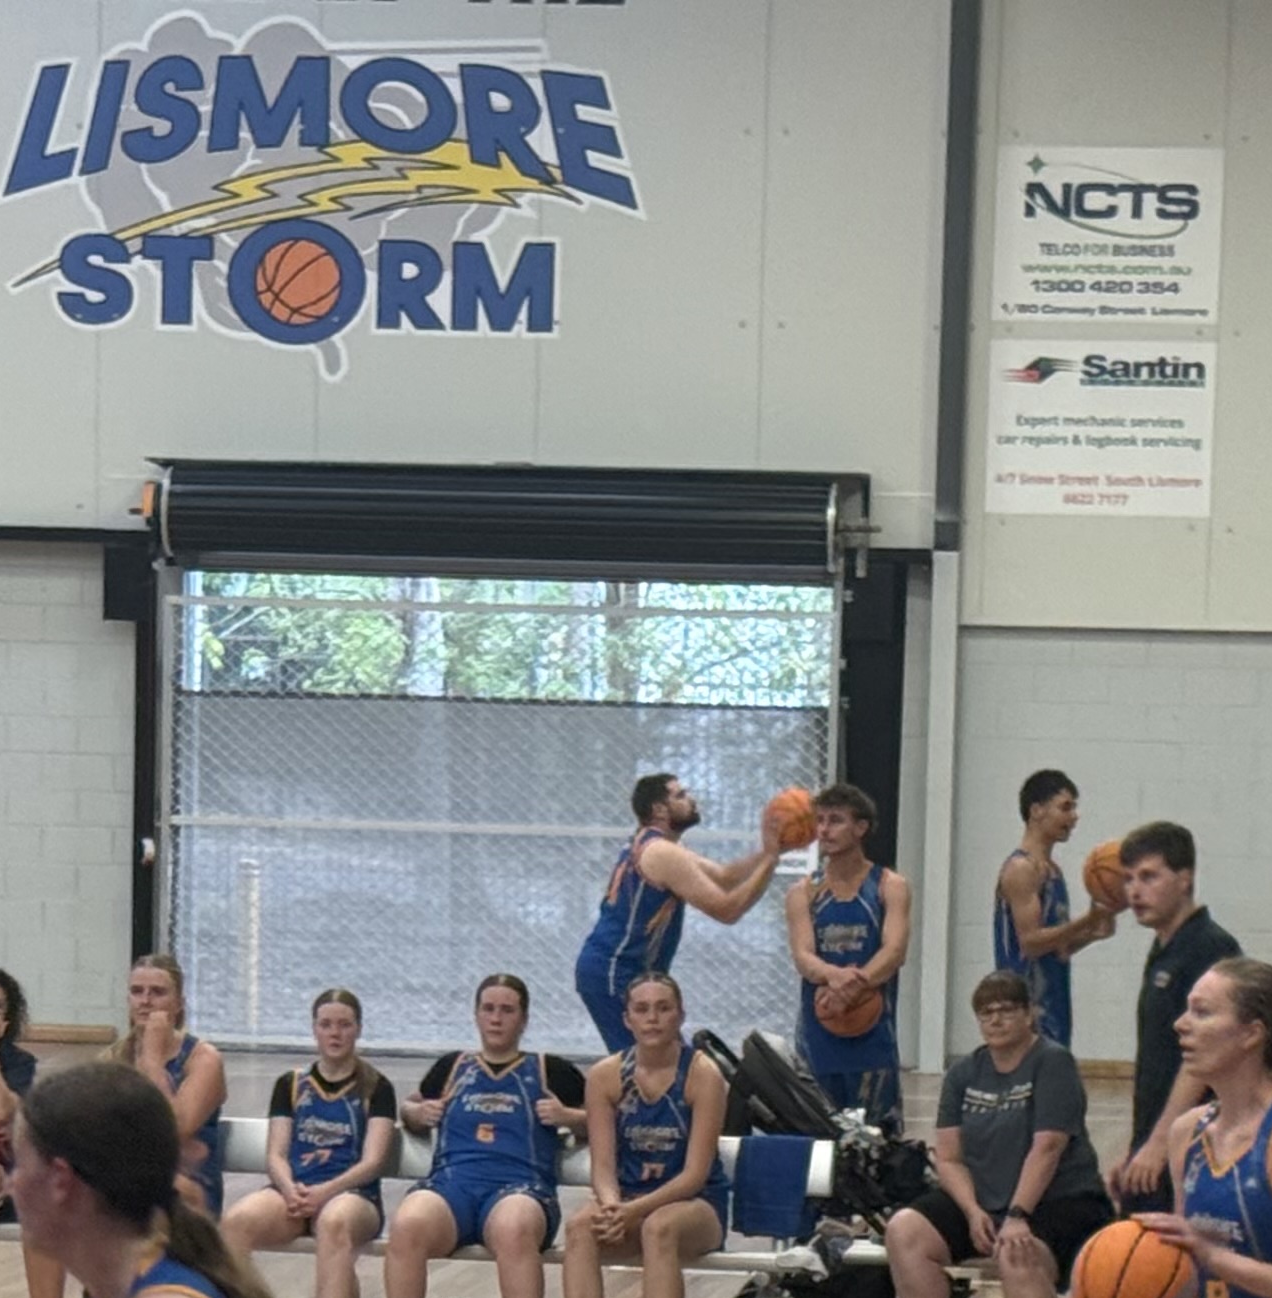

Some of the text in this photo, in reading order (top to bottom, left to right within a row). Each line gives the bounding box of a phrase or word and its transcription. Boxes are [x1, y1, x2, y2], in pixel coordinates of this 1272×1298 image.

[3, 54, 640, 210] LISMORE
[1024, 182, 1200, 220] NCTS
[1039, 243, 1081, 257] TELCO
[57, 218, 557, 345] STORM
[1030, 280, 1085, 293] 1300
[1089, 281, 1133, 293] 420
[1082, 354, 1205, 379] Santin
